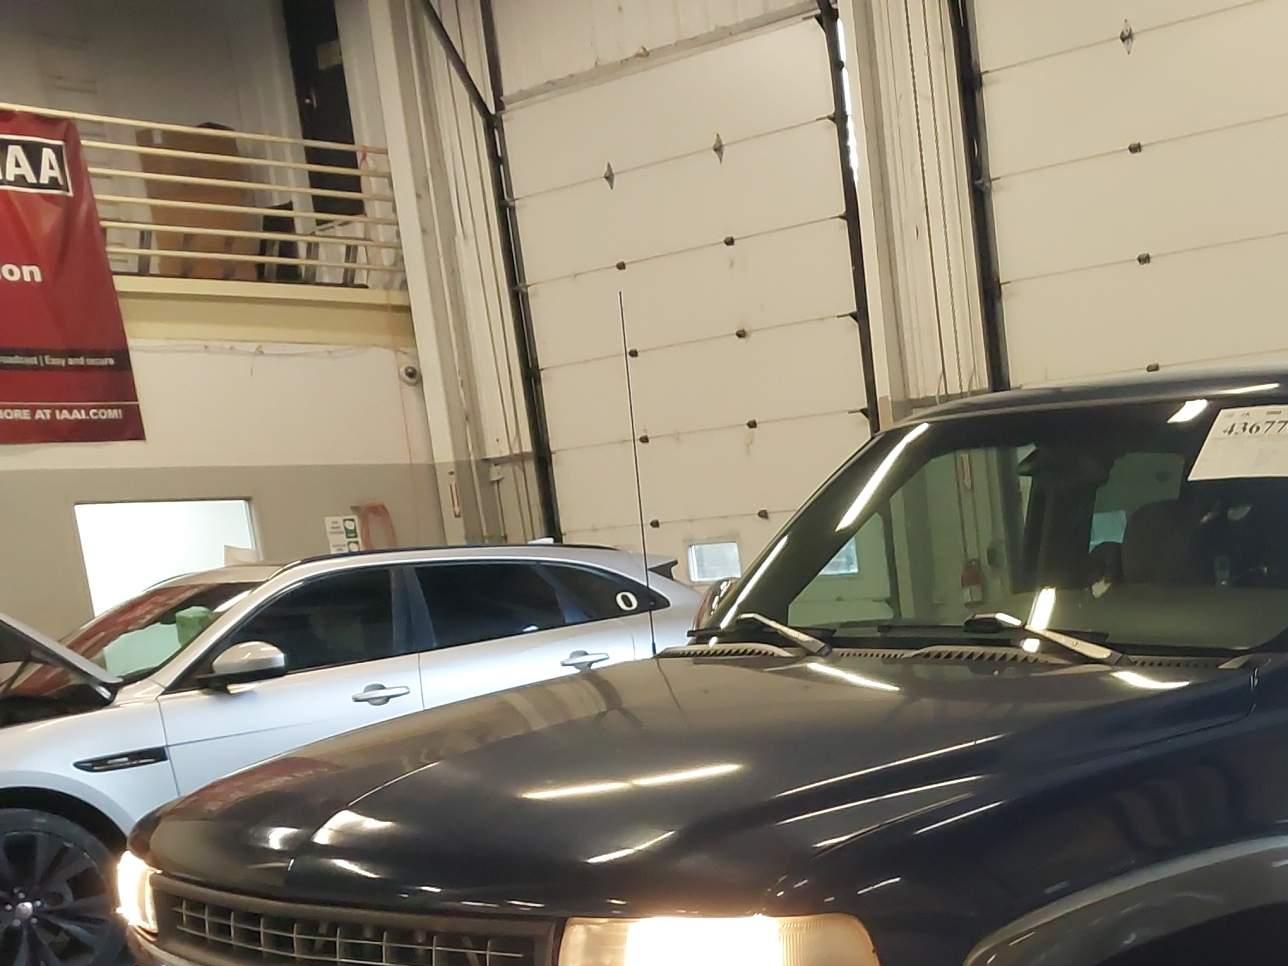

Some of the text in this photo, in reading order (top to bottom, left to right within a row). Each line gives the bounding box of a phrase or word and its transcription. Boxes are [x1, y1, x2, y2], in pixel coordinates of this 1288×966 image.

[0, 144, 64, 186] AA
[0, 263, 42, 282] on
[34, 408, 52, 420] AT
